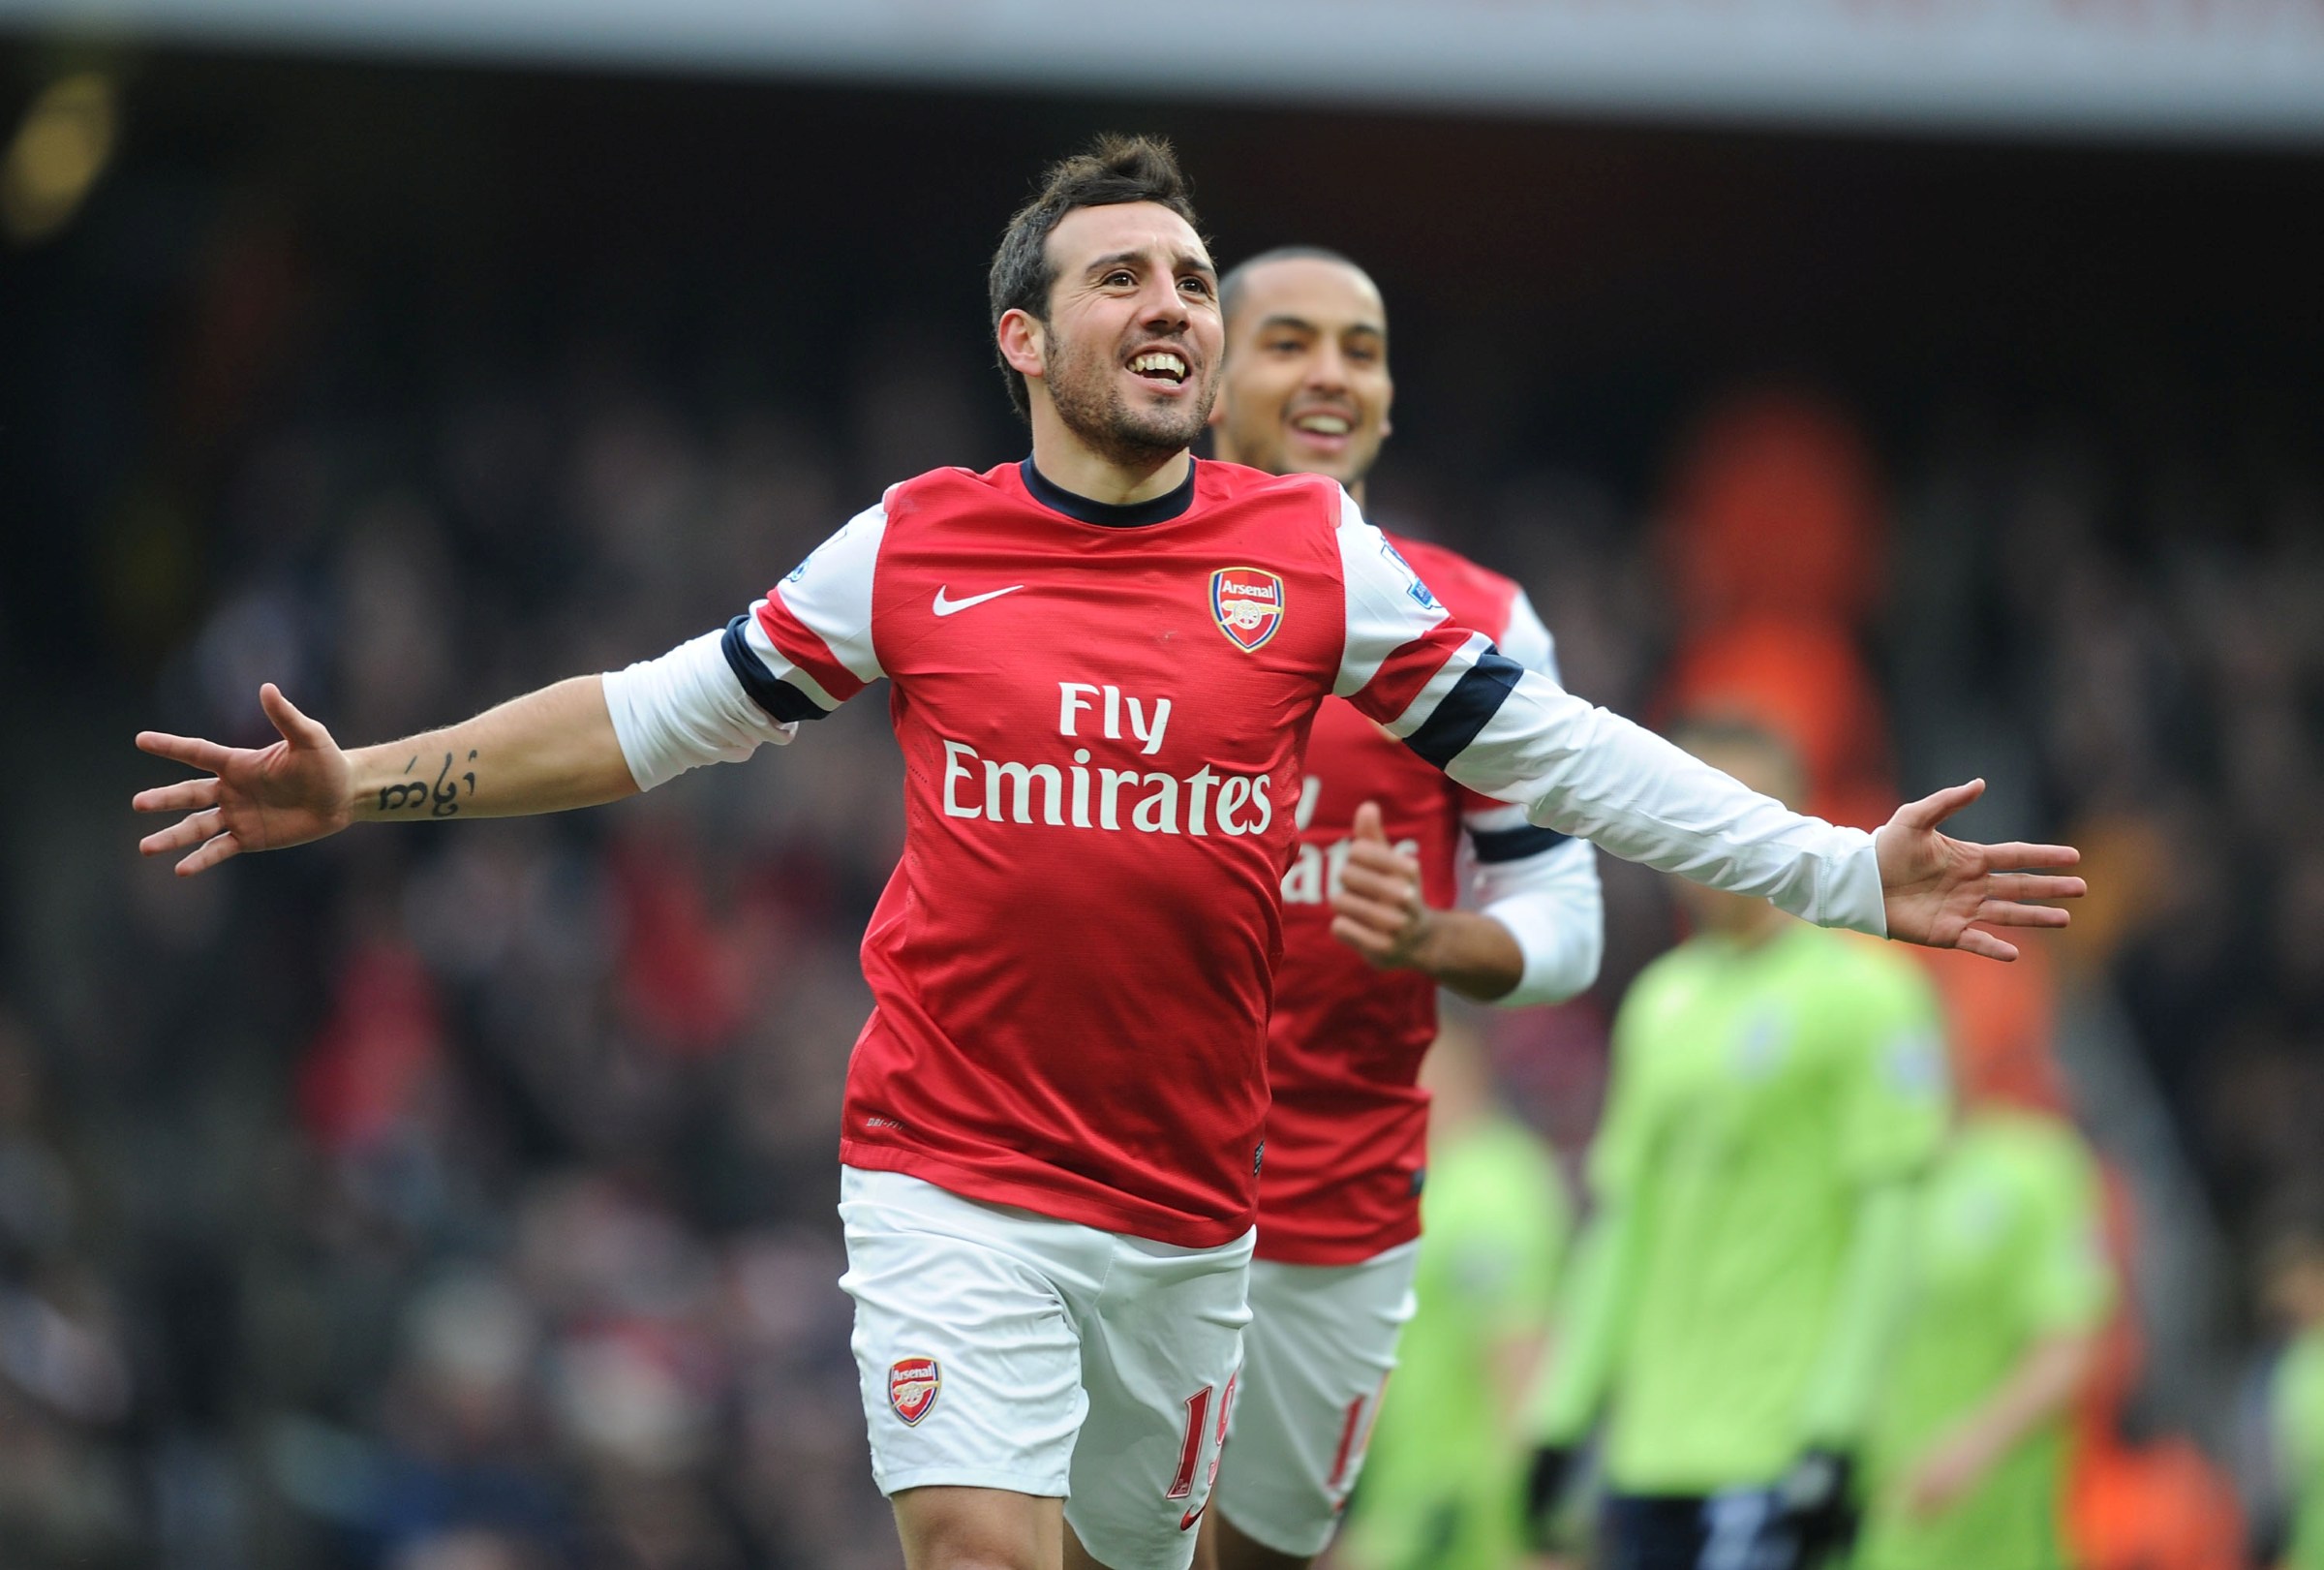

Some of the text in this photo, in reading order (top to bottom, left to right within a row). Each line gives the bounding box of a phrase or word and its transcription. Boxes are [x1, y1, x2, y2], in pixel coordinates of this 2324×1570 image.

[1222, 580, 1274, 599] Arsenal
[1059, 682, 1172, 754] Fly
[943, 740, 1271, 836] Emirates
[892, 1366, 933, 1381] Arsenal
